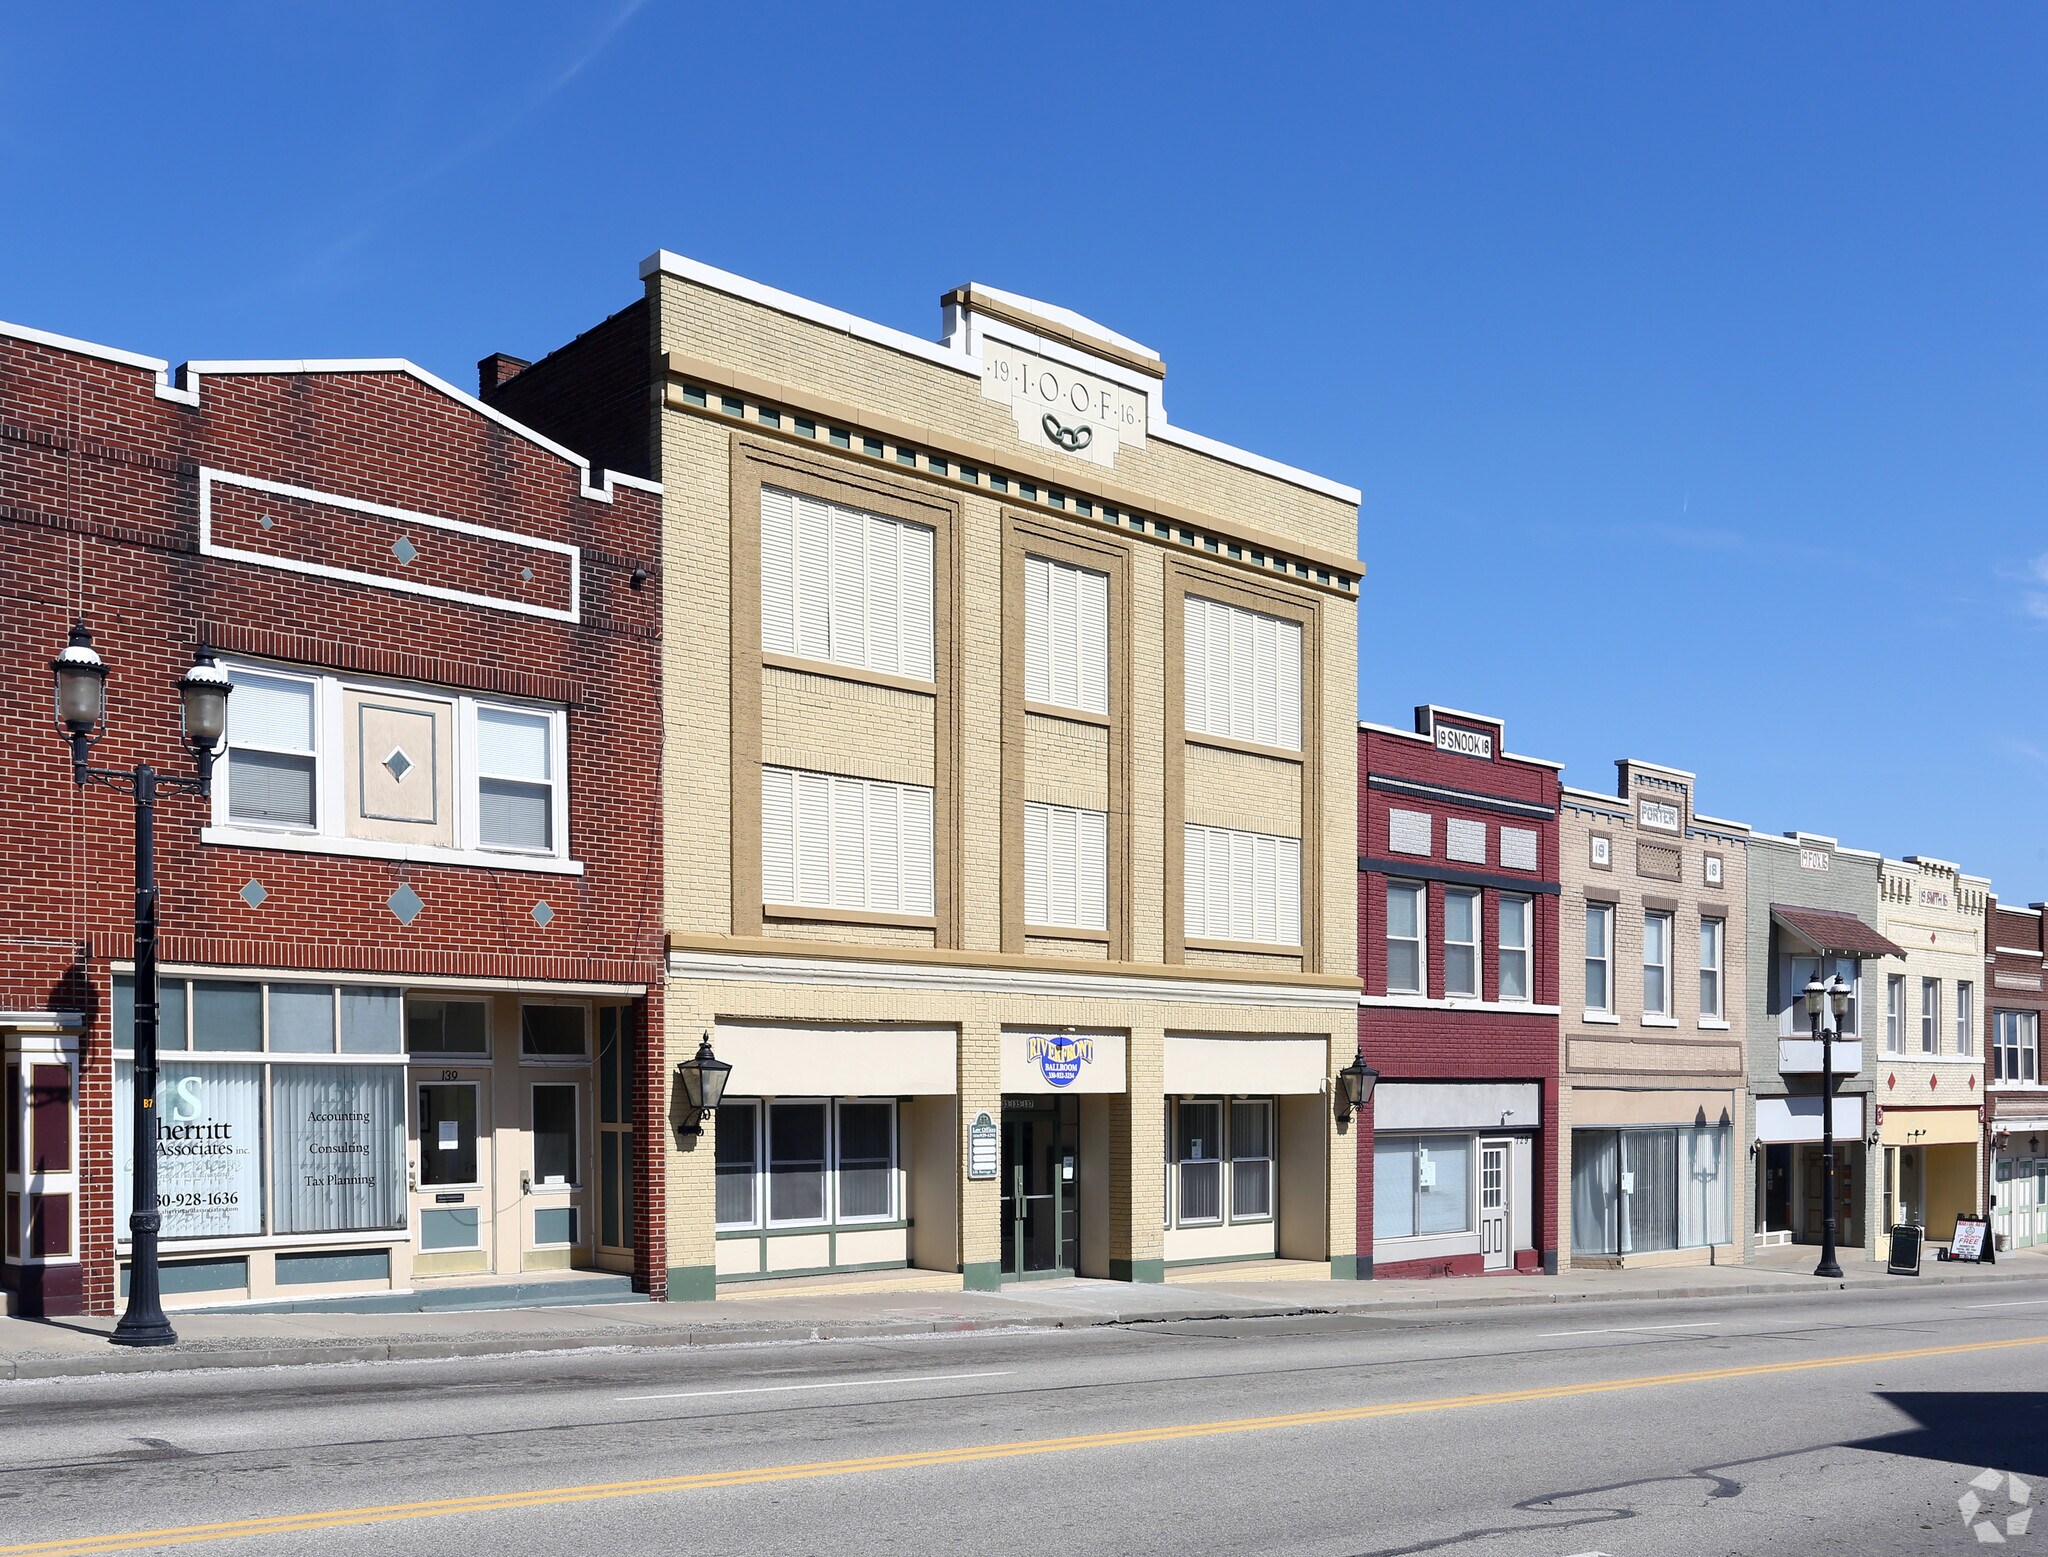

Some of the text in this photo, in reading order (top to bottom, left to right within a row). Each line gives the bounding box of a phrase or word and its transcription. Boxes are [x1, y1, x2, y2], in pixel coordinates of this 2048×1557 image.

[994, 359, 1009, 382] 19
[1120, 403, 1135, 425] 16
[1438, 729, 1490, 754] 19 SNOOK 18
[1641, 804, 1676, 826] PORTER
[1595, 843, 1605, 858] 19
[1709, 863, 1718, 877] 18
[1029, 1037, 1093, 1062] RIVERFRONT
[1044, 1063, 1078, 1072] BALLROOM
[441, 1070, 458, 1081] 139
[143, 1098, 153, 1108] B7
[173, 1076, 203, 1122] S
[307, 1111, 371, 1125] Accounting
[156, 1116, 232, 1140] herritt
[157, 1140, 250, 1155] Associates inc.
[309, 1141, 370, 1156] Consulting
[304, 1173, 376, 1188] Tax Planning
[157, 1191, 239, 1207] 30-928-1636
